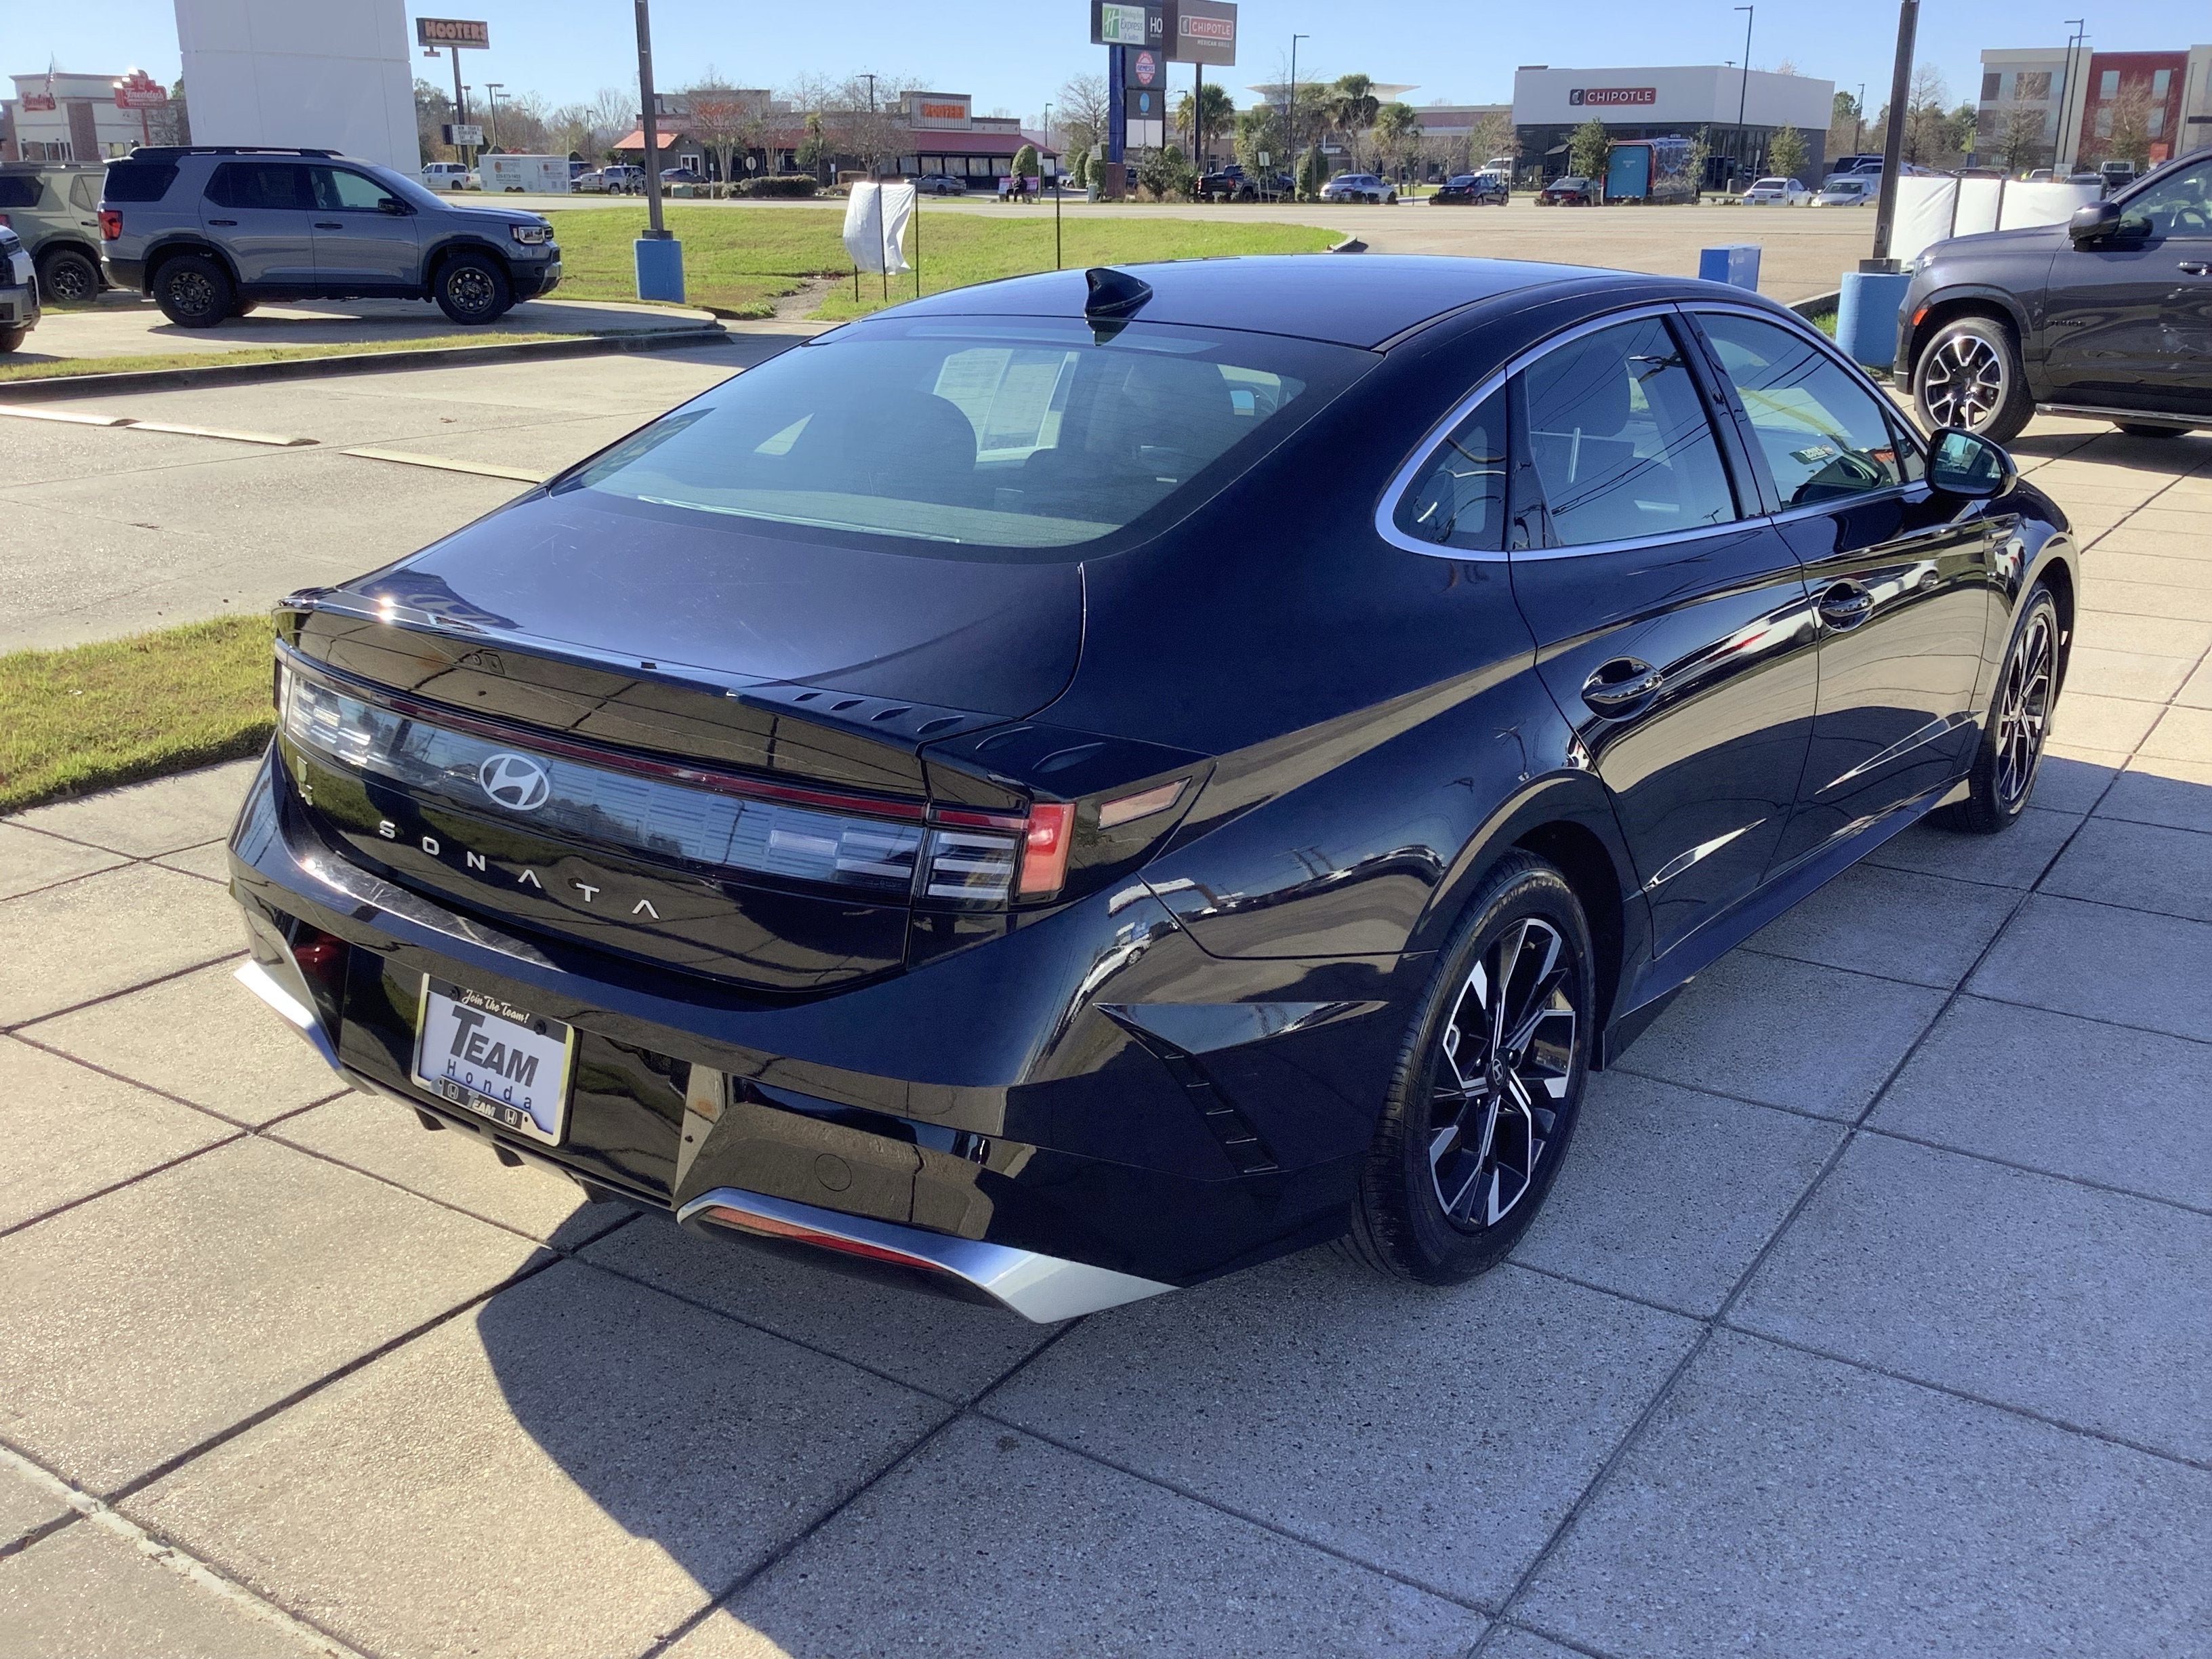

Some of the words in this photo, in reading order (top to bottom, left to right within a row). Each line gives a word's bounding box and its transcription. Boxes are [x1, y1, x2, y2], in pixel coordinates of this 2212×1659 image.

[425, 21, 486, 40] HOOTERS
[1120, 18, 1143, 33] Express
[1192, 22, 1231, 35] CHIPOTLE
[124, 87, 165, 102] Freddy's
[1587, 91, 1652, 102] CHIPOTLE
[380, 819, 659, 920] SONATA
[462, 989, 483, 1006] Join
[483, 995, 500, 1012] The
[500, 1002, 530, 1023] Team!
[449, 1004, 539, 1088] TEAM
[447, 1059, 532, 1110] Honda
[467, 1091, 496, 1117] TEAM
